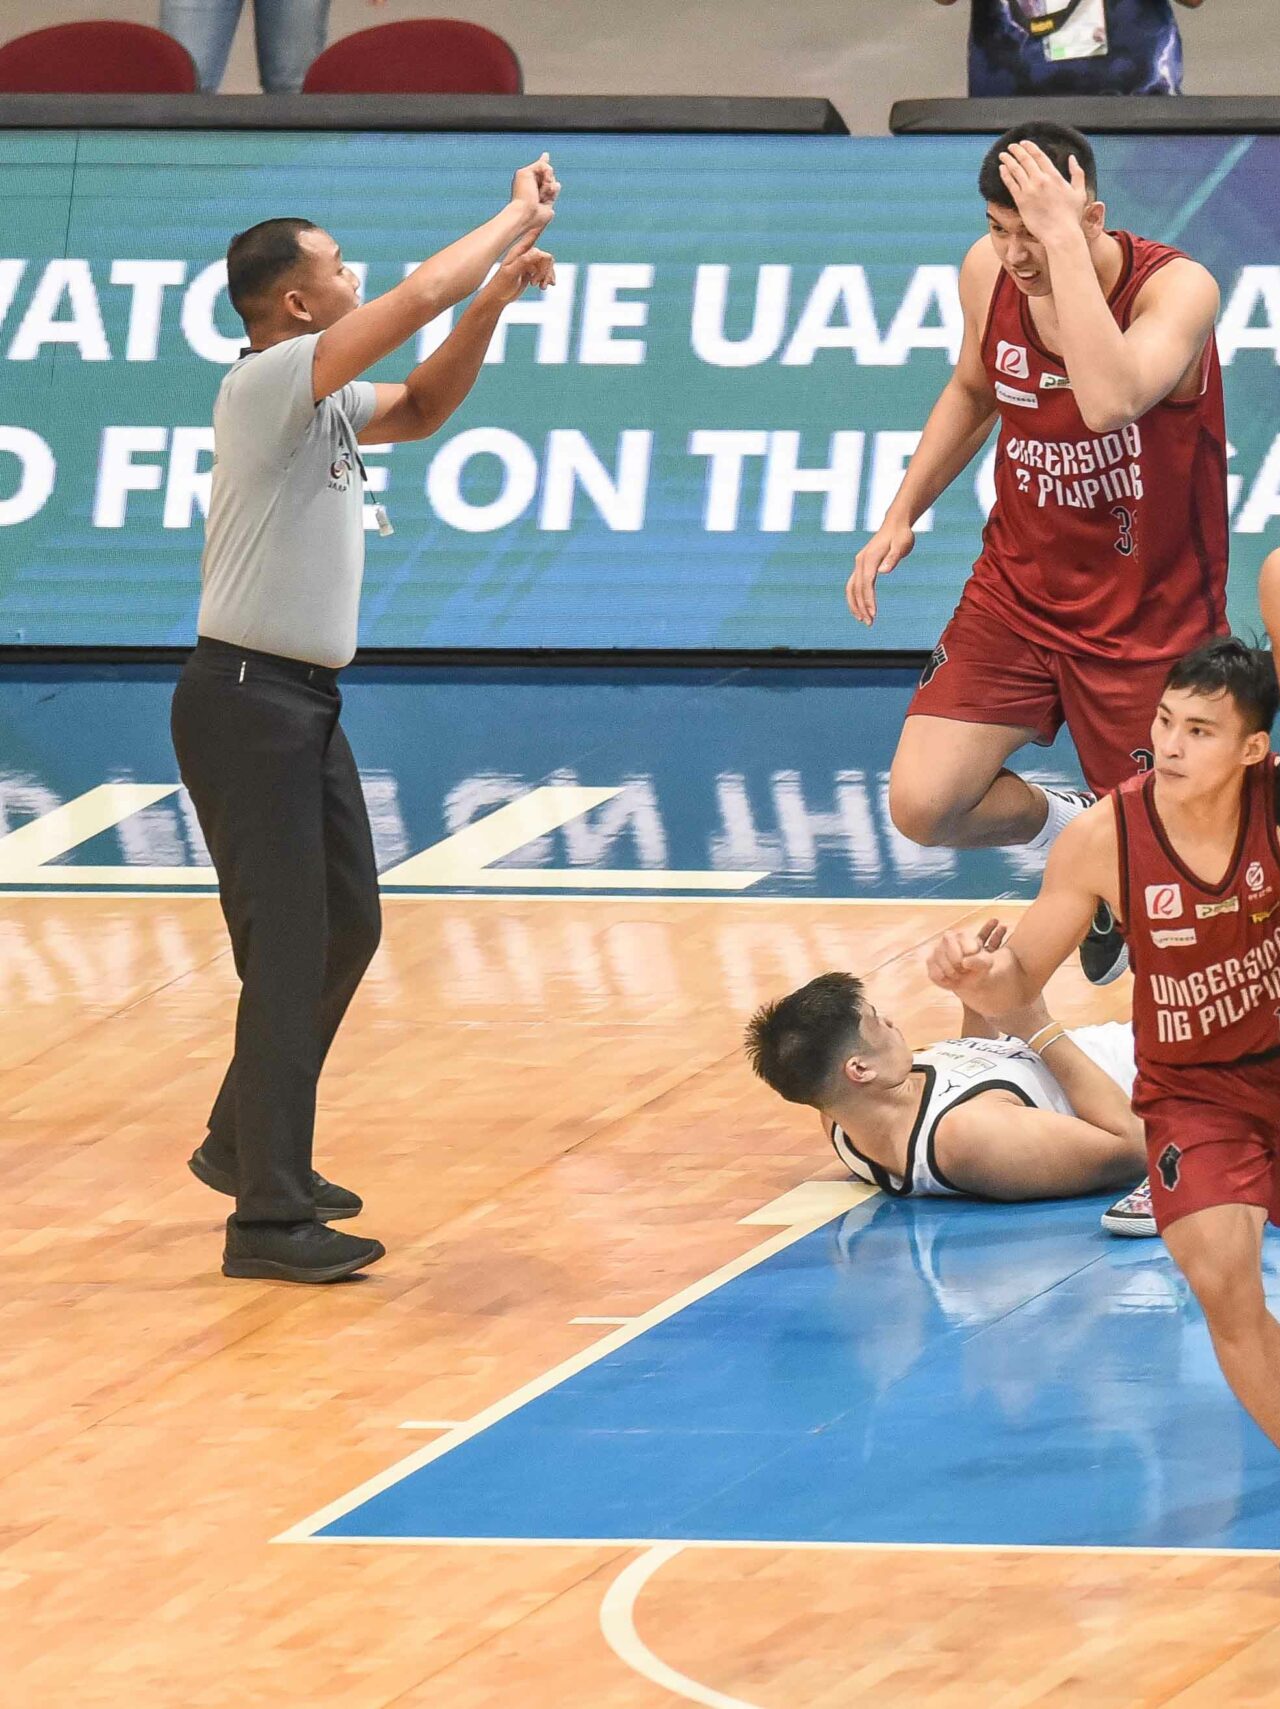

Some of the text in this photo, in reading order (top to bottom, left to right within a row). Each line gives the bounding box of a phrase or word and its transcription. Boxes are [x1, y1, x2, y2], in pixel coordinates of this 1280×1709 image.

[691, 264, 965, 367] UAA
[427, 427, 653, 532] ON
[1110, 505, 1134, 556] 3
[1157, 1009, 1193, 1043] NG
